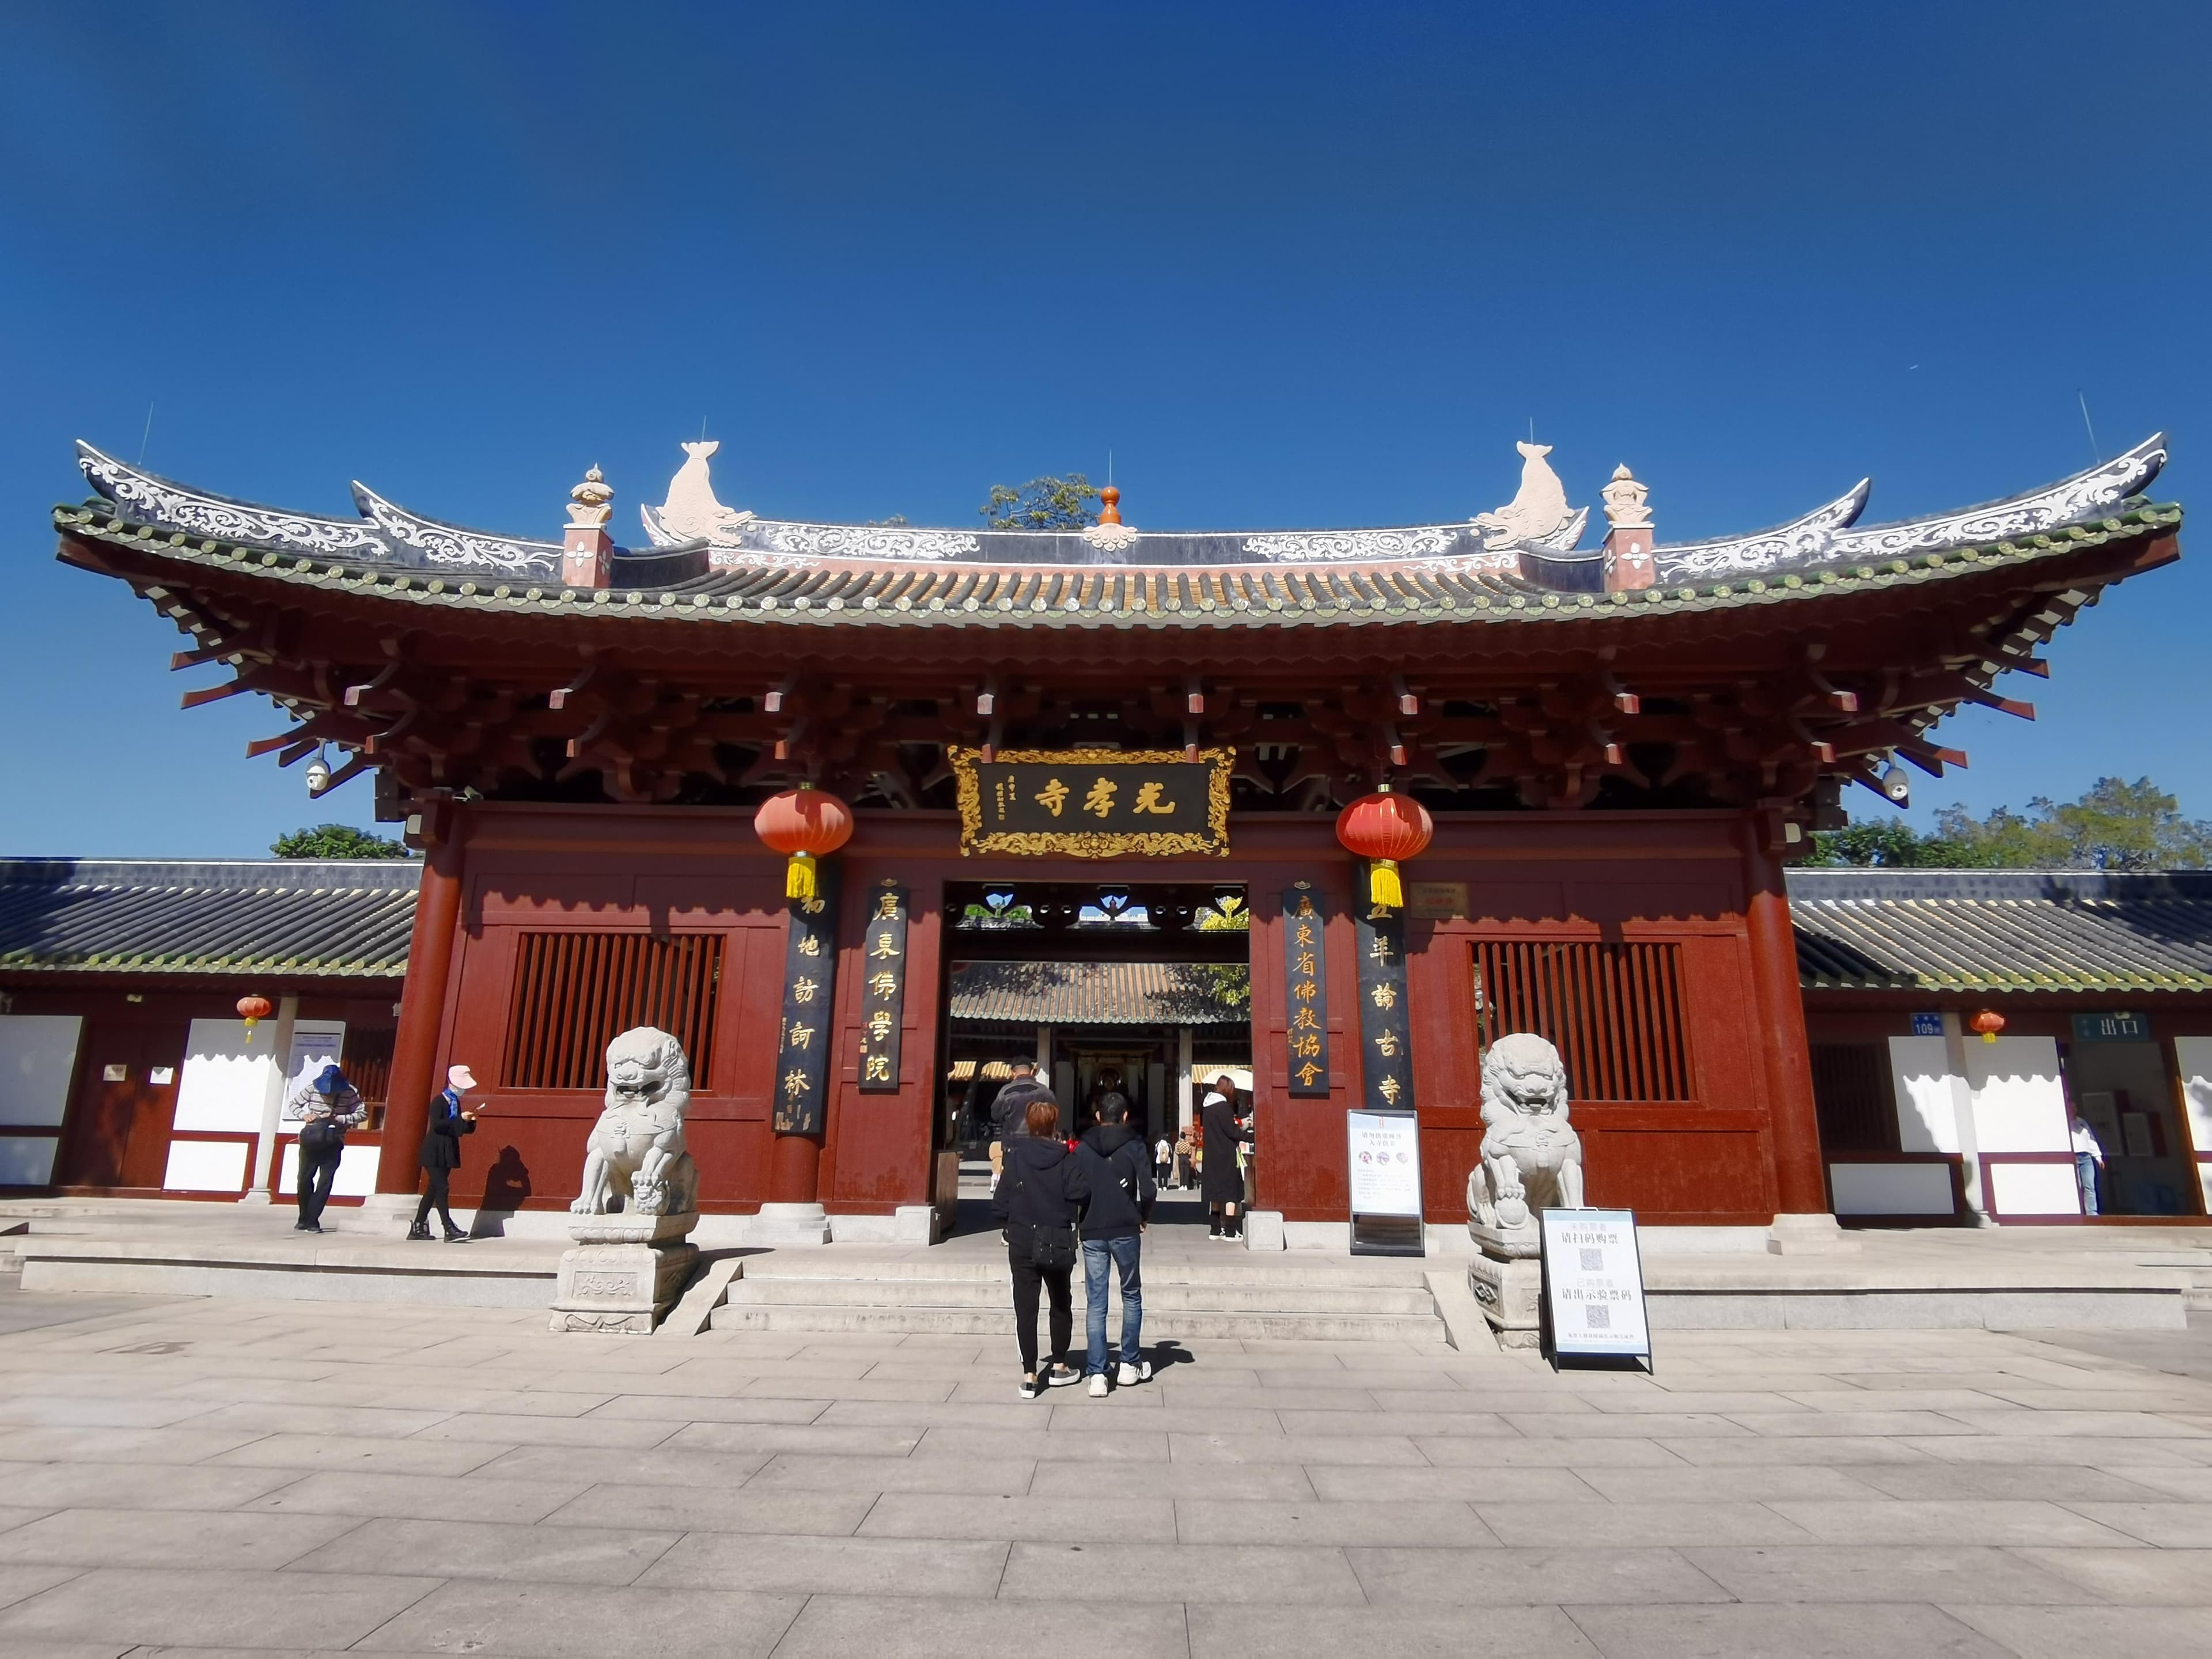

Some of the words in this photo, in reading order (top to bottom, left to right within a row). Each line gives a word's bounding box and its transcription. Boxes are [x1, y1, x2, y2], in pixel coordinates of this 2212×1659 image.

[1035, 777, 1176, 817] 光孝寺
[1291, 895, 1323, 1087] 廣東省佛教協會
[2101, 1018, 2138, 1035] 出口
[1562, 1232, 1618, 1244] 请扫码购票
[1562, 1288, 1631, 1301] 请出示验票码
